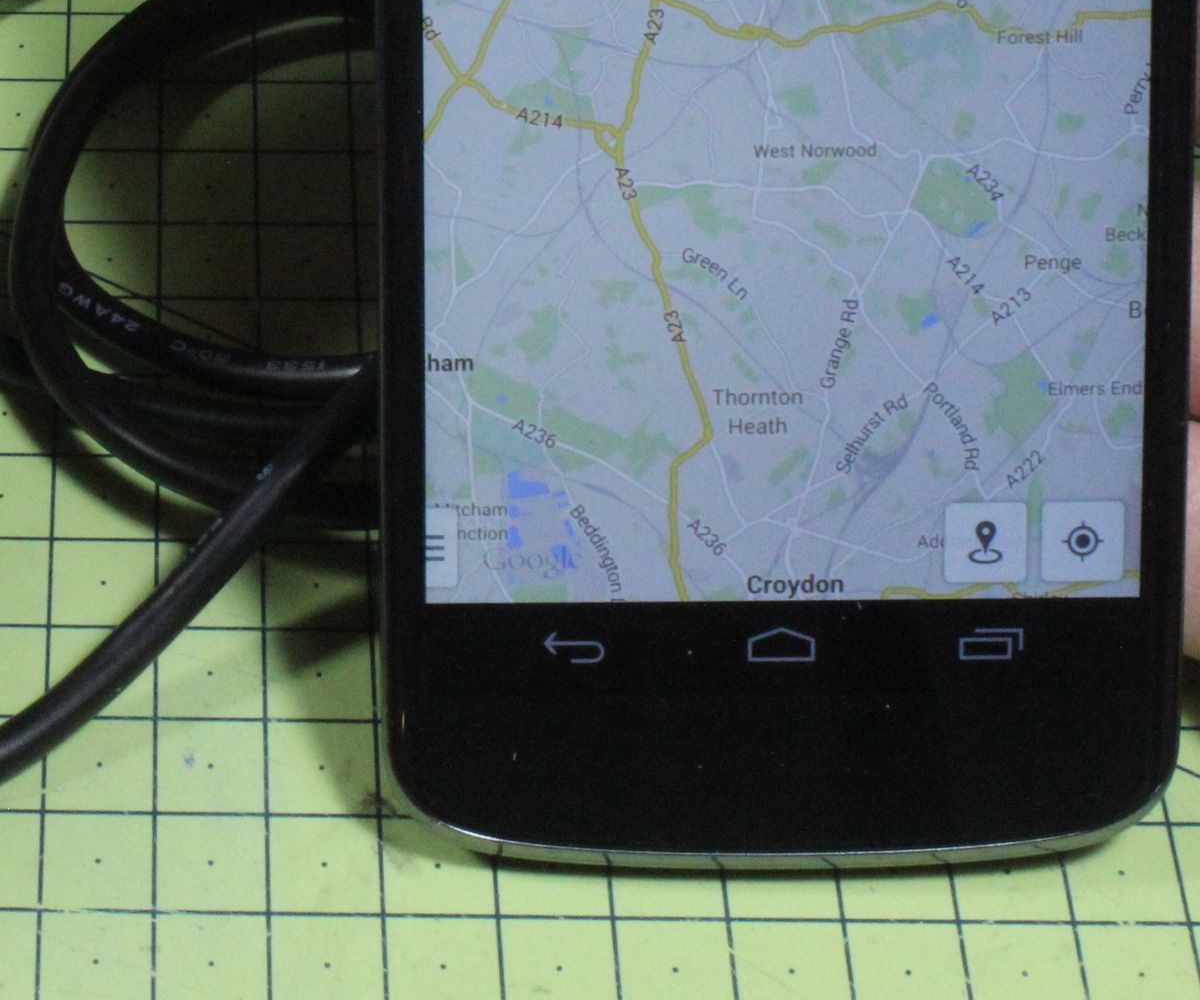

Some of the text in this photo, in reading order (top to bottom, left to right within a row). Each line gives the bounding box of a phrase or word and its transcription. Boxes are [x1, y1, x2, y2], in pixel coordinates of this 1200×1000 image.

[643, 8, 665, 44] A23
[997, 29, 1084, 45] Forest Hill
[516, 107, 563, 129] A214
[753, 143, 877, 158] West Norwood
[614, 167, 638, 202] A23
[966, 163, 1005, 202] A234
[682, 247, 748, 300] Green Ln
[946, 256, 985, 295] A214
[1024, 255, 1082, 272] Penge
[991, 287, 1032, 325] A213
[663, 311, 686, 342] A23
[820, 299, 860, 390] Grange Rd
[713, 388, 803, 405] Thornton
[1048, 381, 1142, 397] Elmers End
[512, 419, 556, 449] A236
[728, 418, 787, 434] Heath
[835, 392, 910, 474] Selhurst Rd
[922, 381, 980, 472] Portland Rd
[1005, 449, 1046, 489] A222
[440, 502, 508, 517] tcham
[569, 503, 623, 593] Beddington
[686, 519, 727, 557] A236
[747, 574, 844, 599] Croydon
